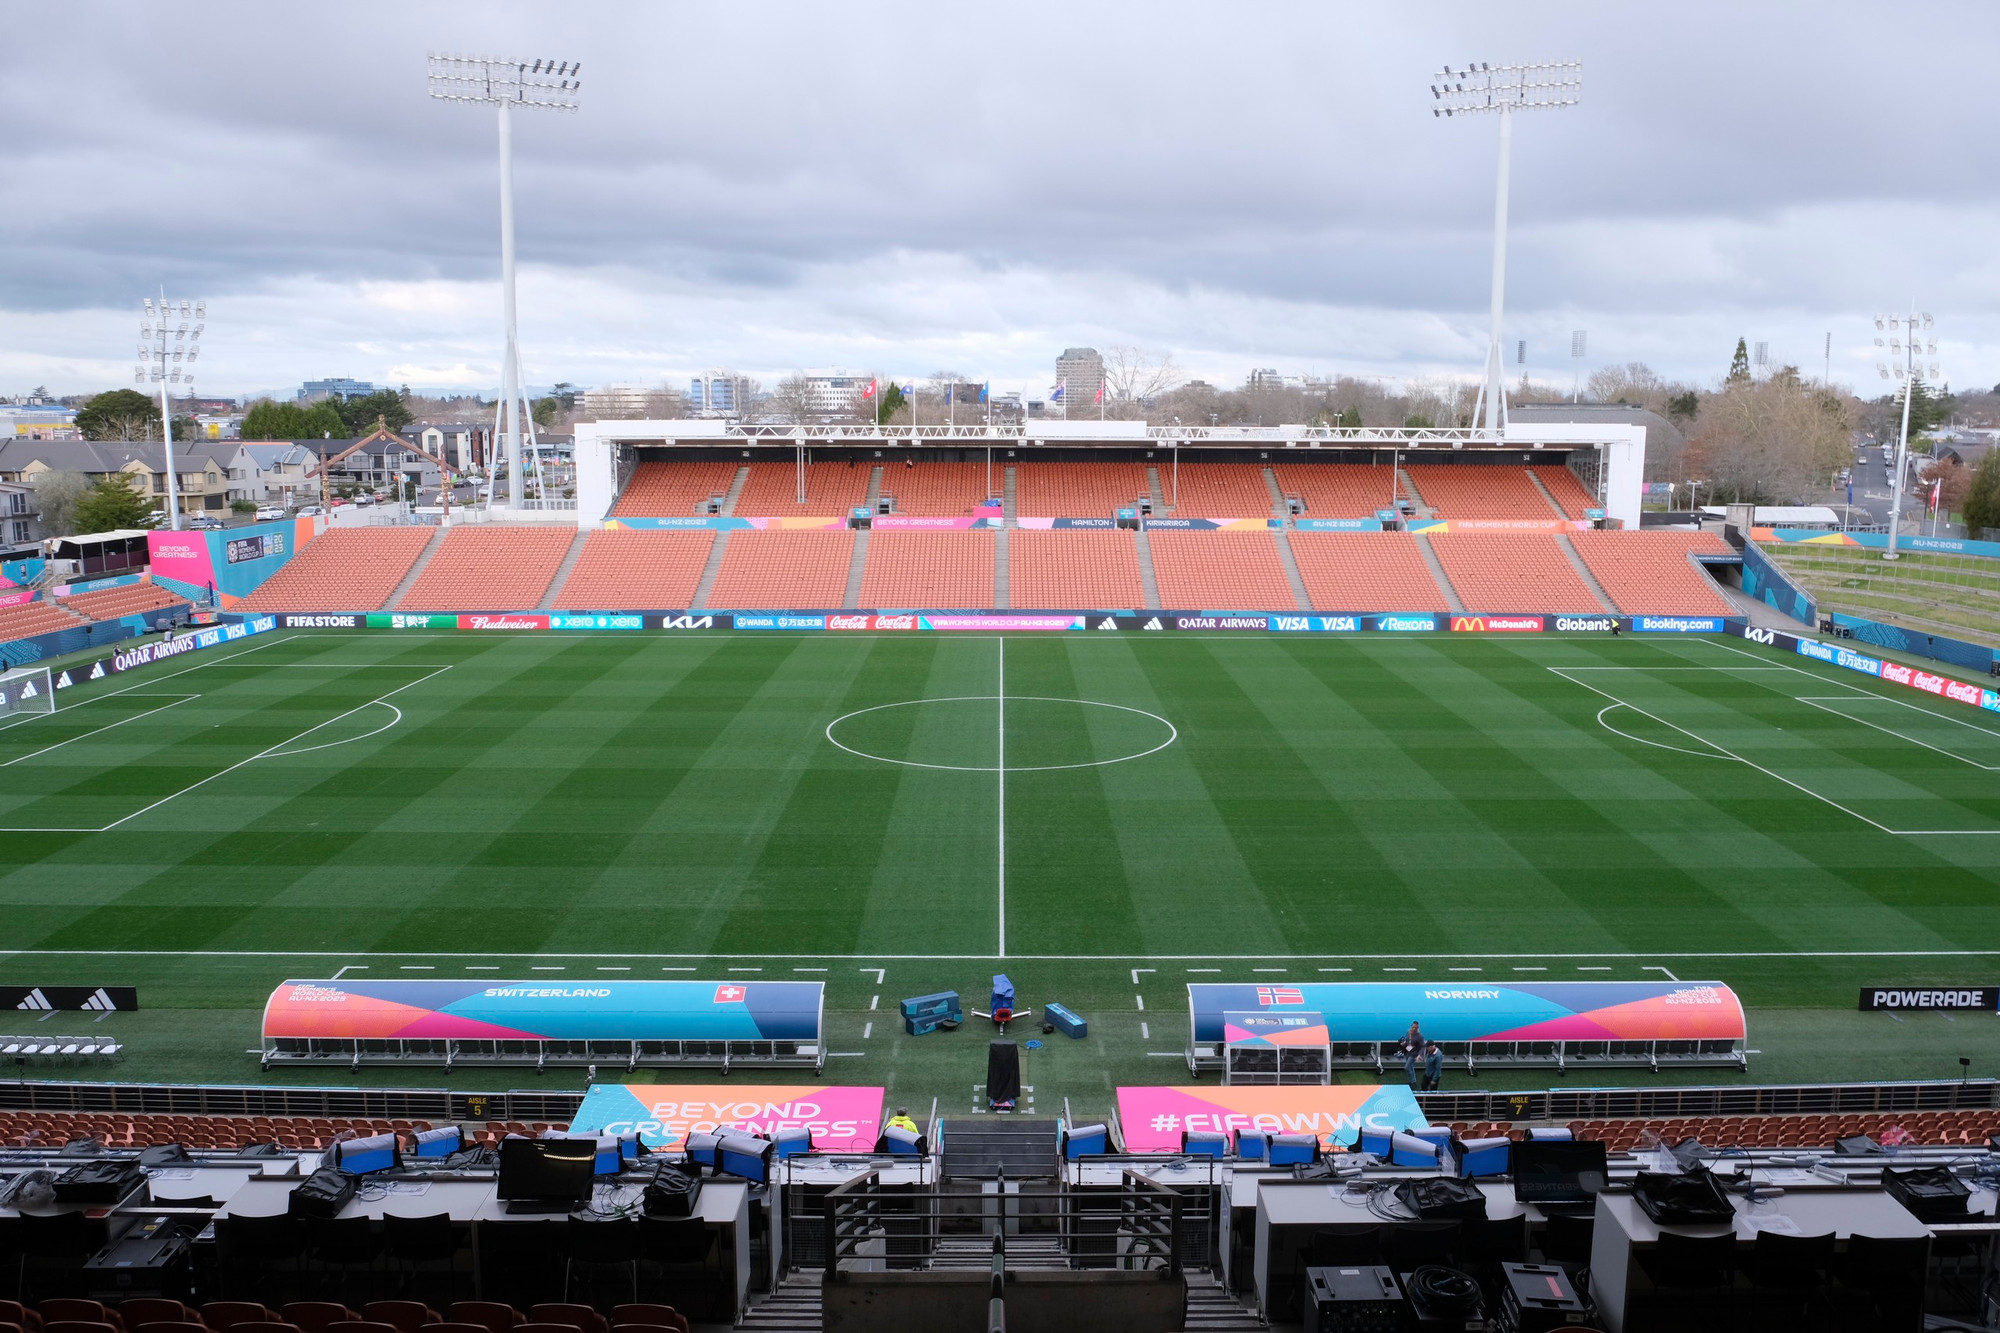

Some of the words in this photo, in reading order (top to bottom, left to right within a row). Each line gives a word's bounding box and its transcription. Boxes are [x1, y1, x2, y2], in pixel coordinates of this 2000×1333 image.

[877, 518, 908, 526] BEYOND
[252, 618, 273, 634] VISA
[286, 616, 315, 626] FIFA
[315, 616, 355, 626] STORE
[470, 616, 538, 629] Budweiser
[564, 618, 594, 627] xero
[610, 618, 640, 627] xero
[1178, 618, 1216, 629] QATAR
[1220, 618, 1266, 628] AIRWAYS
[1275, 618, 1310, 630] VISA
[1321, 618, 1355, 630] VISA
[1388, 618, 1434, 630] Rexona
[1489, 620, 1538, 629] McDonald's
[1643, 618, 1713, 631] Booking.com
[226, 625, 246, 640] VISA
[200, 631, 220, 647] VISA
[115, 648, 150, 671] QATAR
[153, 636, 194, 660] AIRWAYS
[1809, 644, 1832, 660] WANDA
[484, 988, 611, 998] SWITZERLAND
[1425, 990, 1501, 999] NORWAY
[1873, 991, 1984, 1007] POWERADE
[1510, 1096, 1529, 1104] AISLE
[474, 1105, 481, 1116] 5
[649, 1102, 821, 1119] BEYOND
[1515, 1104, 1523, 1115] 7
[1150, 1112, 1395, 1132] #FIFAWWC
